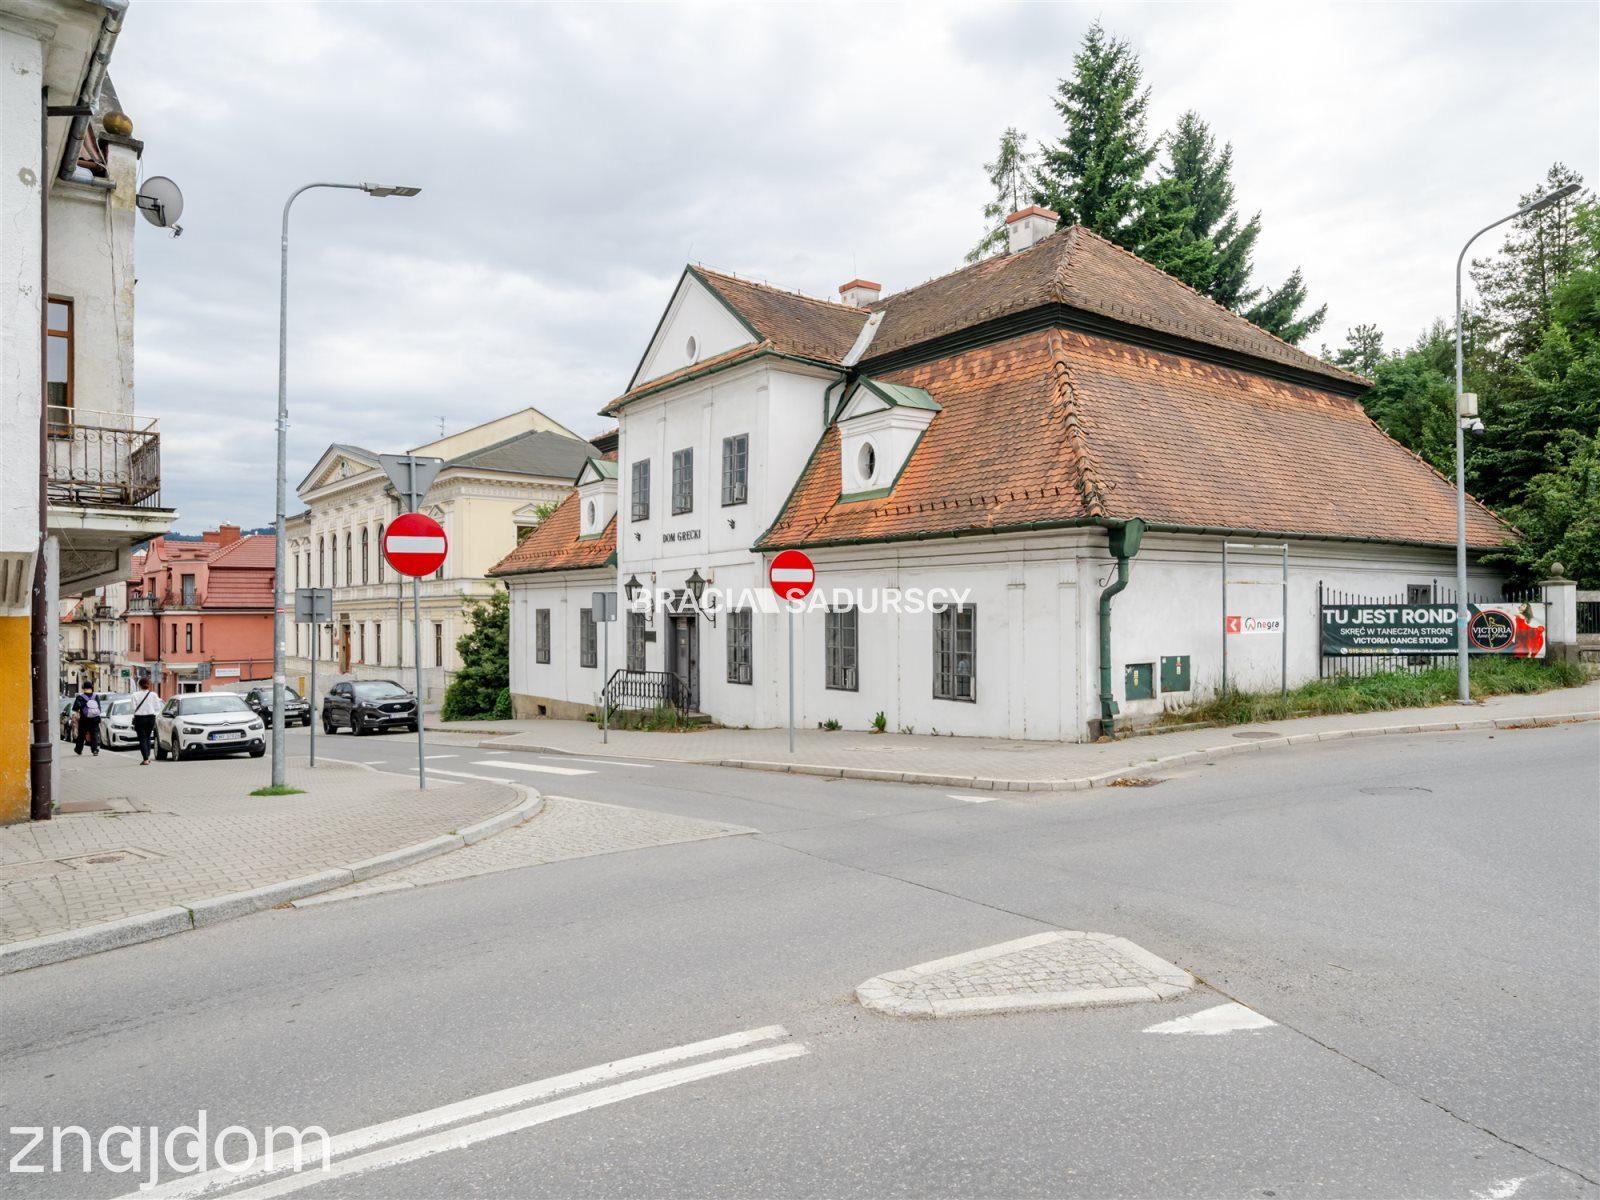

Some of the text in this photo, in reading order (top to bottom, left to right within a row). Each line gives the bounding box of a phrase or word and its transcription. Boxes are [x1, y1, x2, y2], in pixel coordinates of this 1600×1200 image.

[662, 529, 701, 543] DOM GRECKI
[1323, 609, 1348, 624] TU
[1352, 609, 1398, 624] JEST
[1256, 621, 1280, 630] negra
[1340, 626, 1366, 636] SKRĘĆ
[1377, 627, 1420, 636] TANECZNĄ
[1421, 627, 1453, 636] STRONĘ
